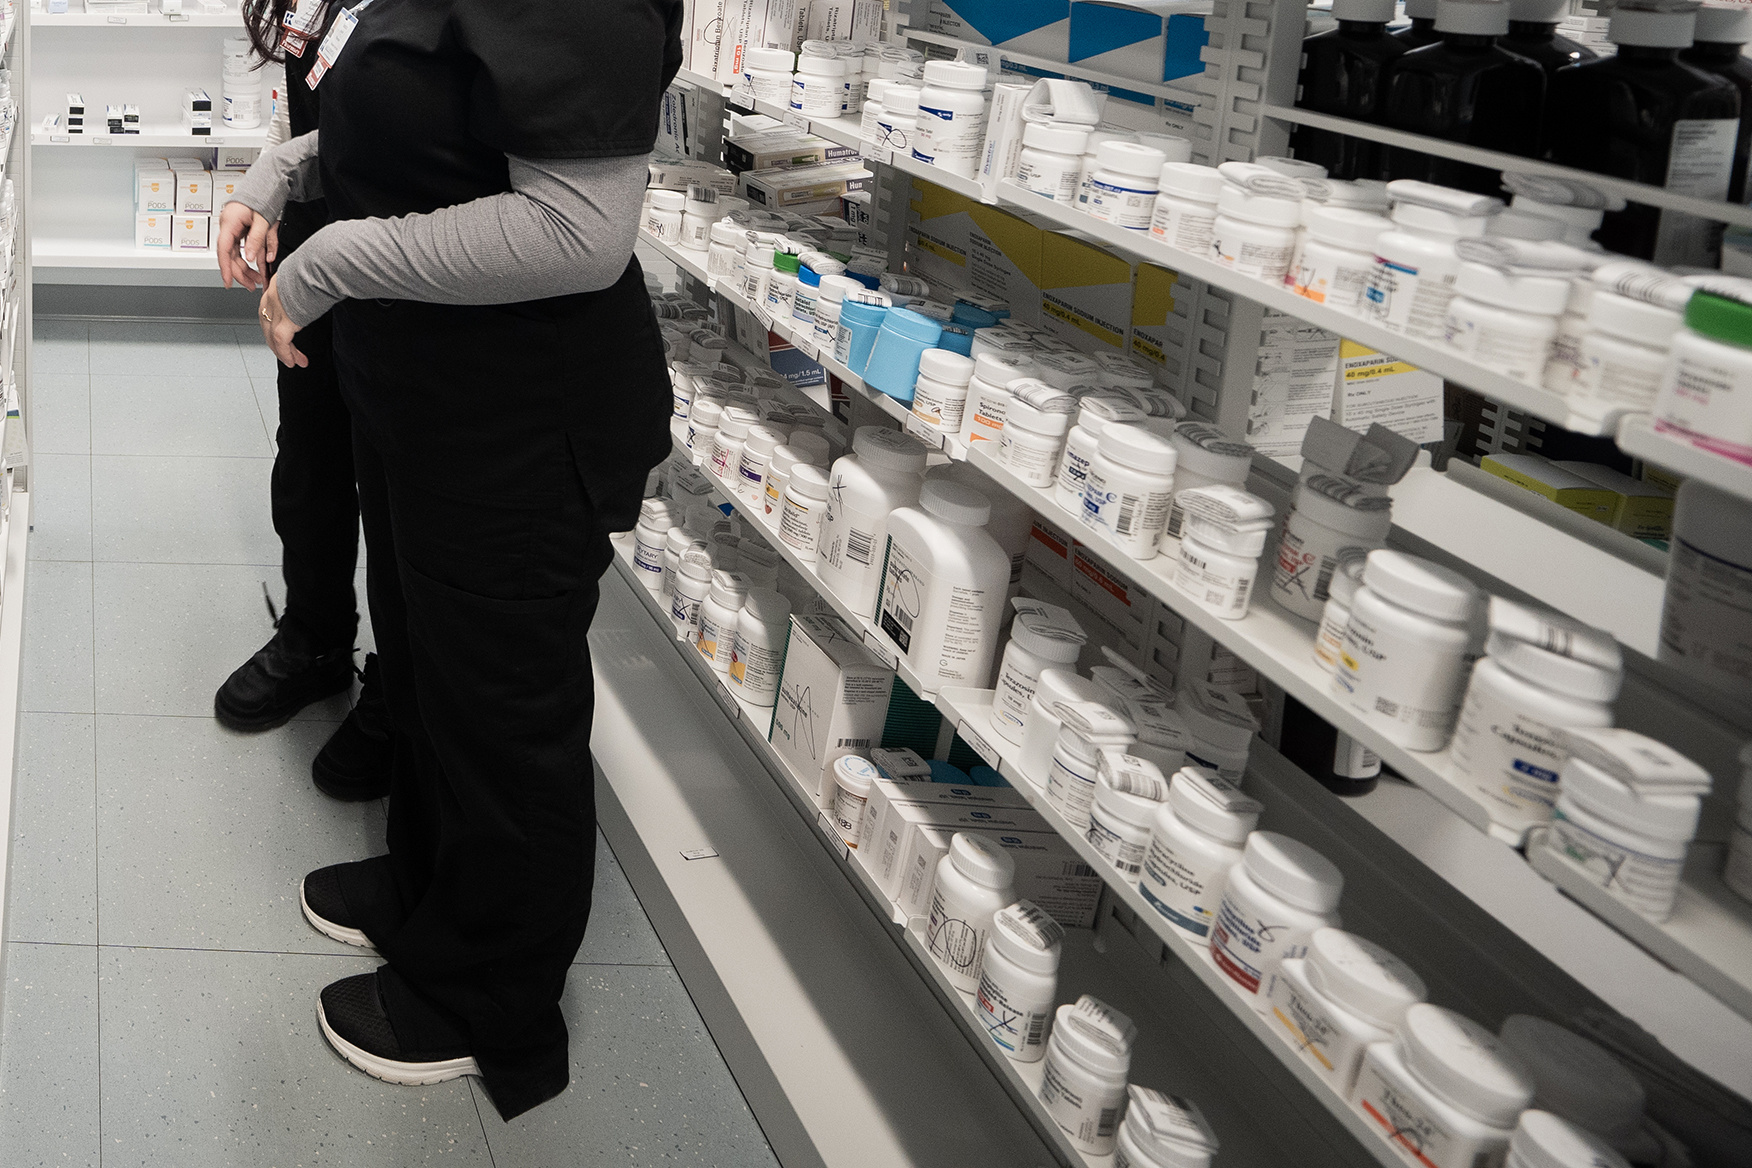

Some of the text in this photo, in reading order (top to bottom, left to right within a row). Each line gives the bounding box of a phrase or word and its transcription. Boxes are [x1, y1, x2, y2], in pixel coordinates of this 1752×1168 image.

[740, 0, 748, 28] Tablets,
[744, 0, 754, 39] Rizatriptan
[796, 7, 806, 35] Tablets,
[826, 6, 834, 34] Tablets,
[736, 45, 743, 56] 10
[671, 94, 680, 143] Zoledronic
[1043, 291, 1124, 336] ENOXAPARIN SODIUM INJECTION
[788, 368, 822, 382] mg/1.5 mL
[1345, 357, 1385, 370] ENOXAPARIN
[1383, 366, 1396, 375] mL
[976, 415, 990, 425] 100
[979, 401, 1006, 416] Spirono
[1004, 672, 1036, 696] Terazosin
